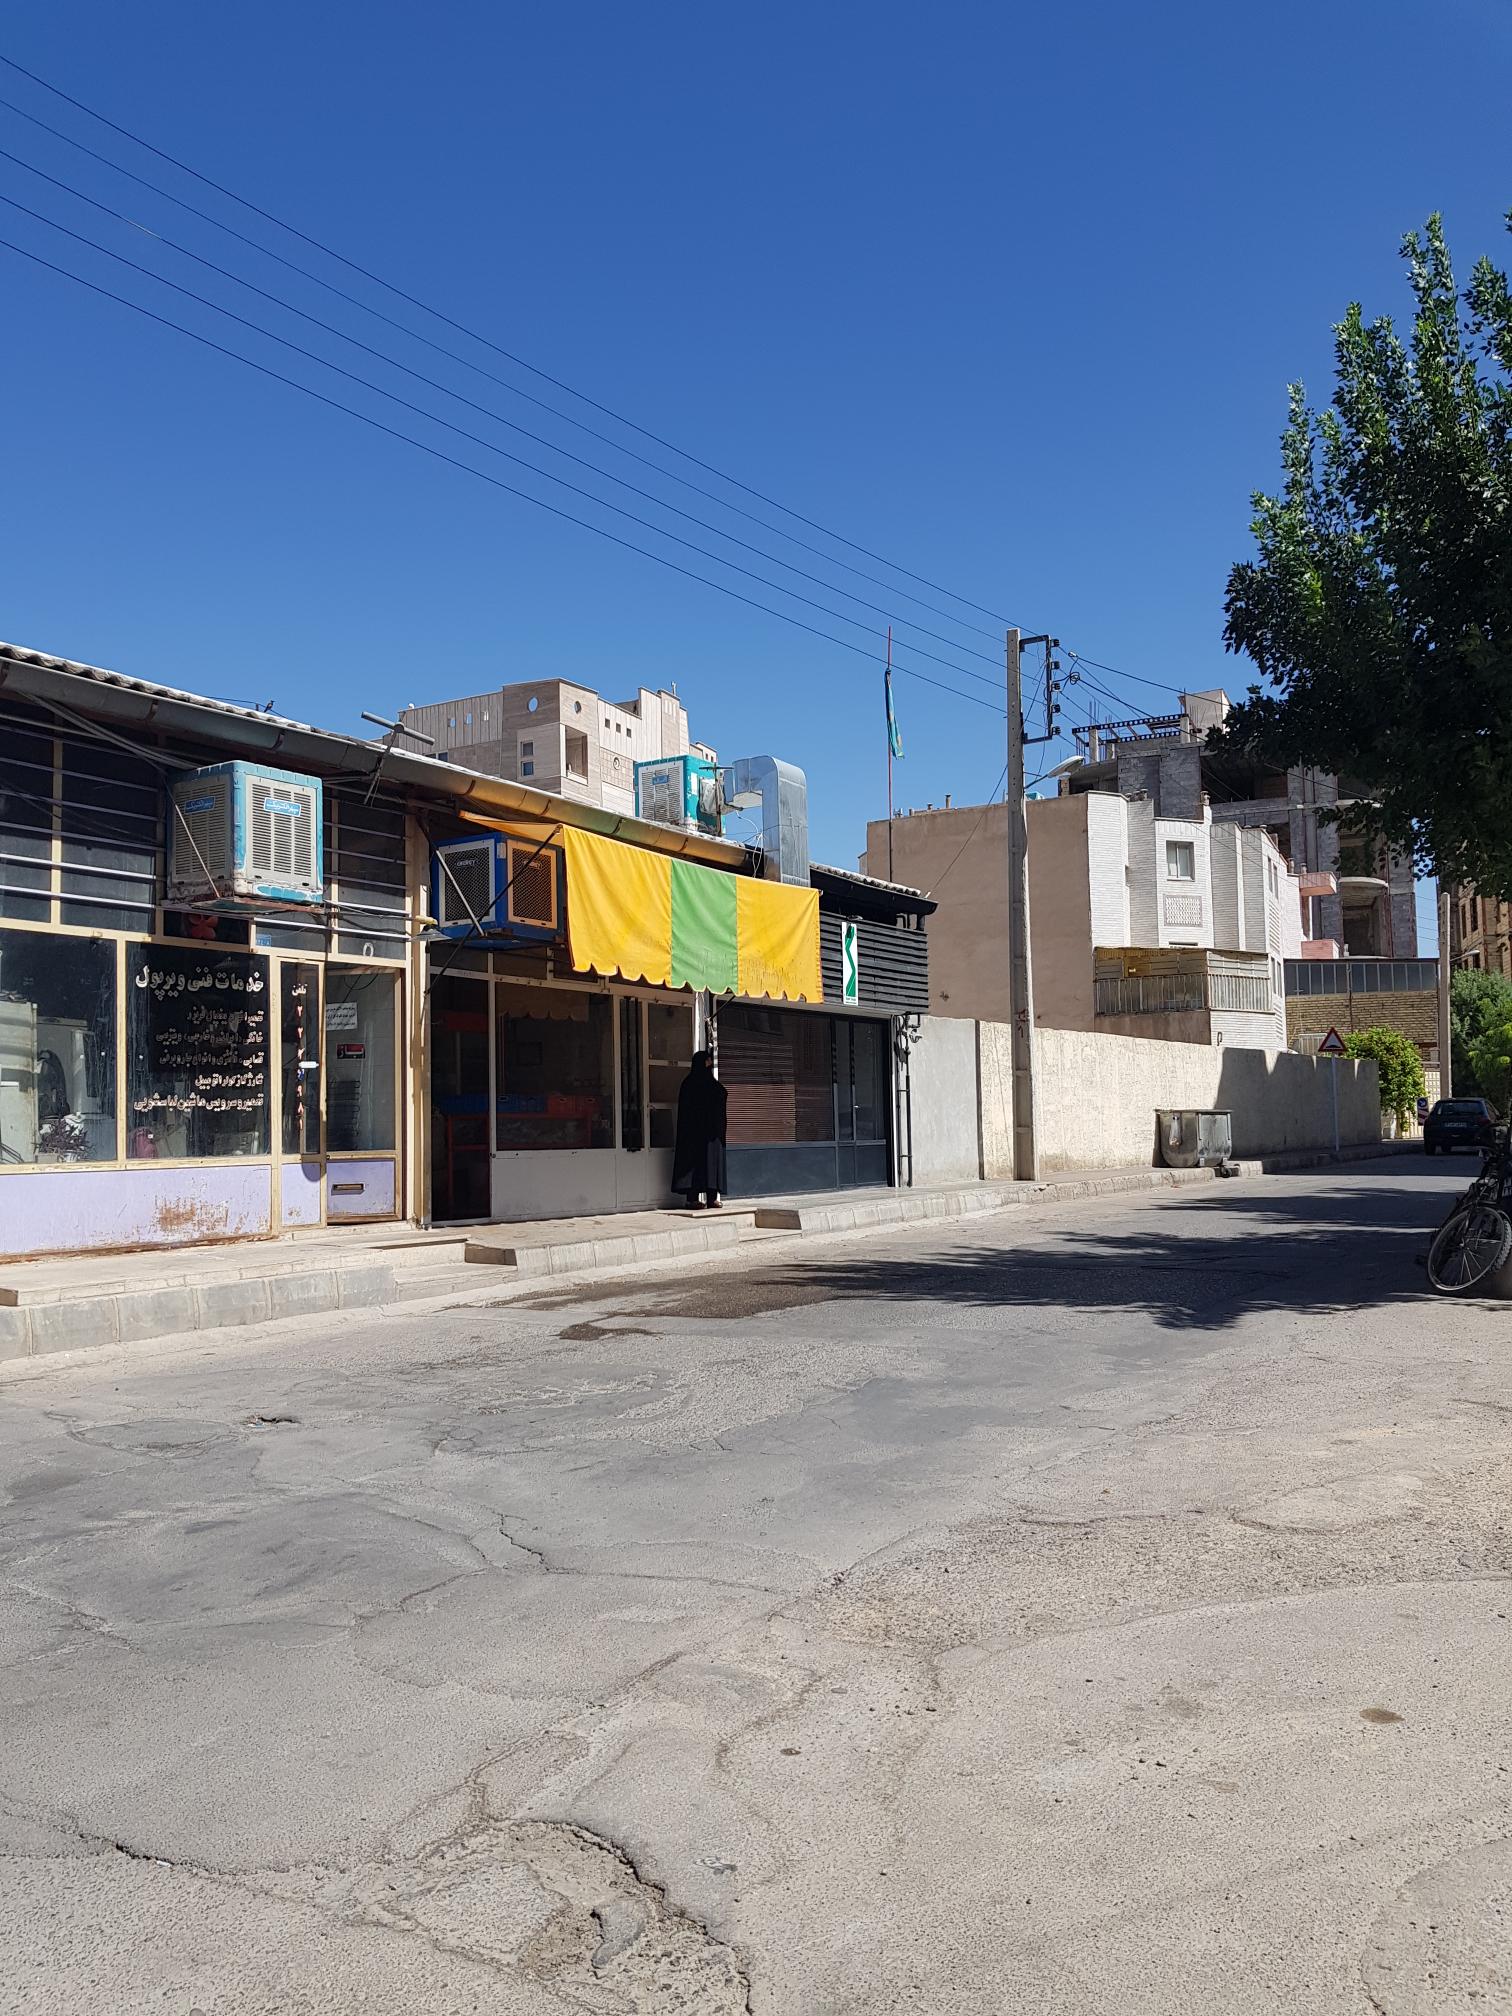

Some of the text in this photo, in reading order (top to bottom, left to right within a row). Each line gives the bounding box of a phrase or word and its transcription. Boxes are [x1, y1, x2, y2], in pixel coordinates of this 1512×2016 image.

[135, 965, 264, 1001] خدمات فنی ویرپول
[291, 983, 308, 996] تلفن
